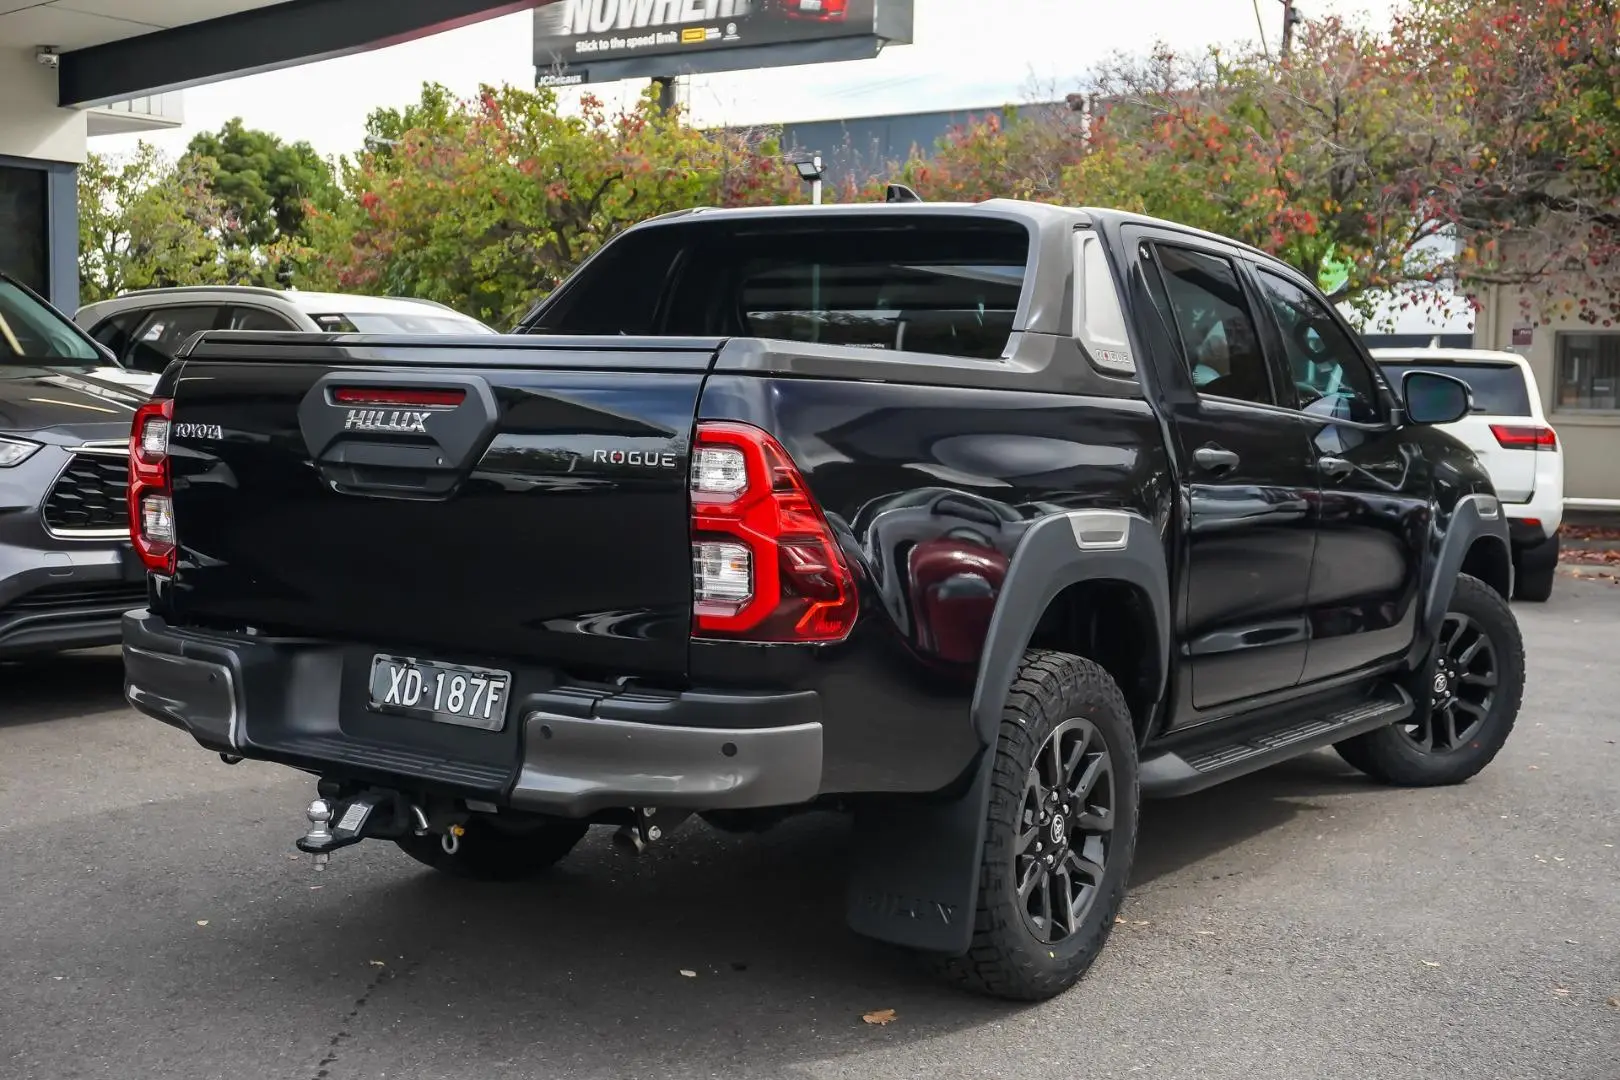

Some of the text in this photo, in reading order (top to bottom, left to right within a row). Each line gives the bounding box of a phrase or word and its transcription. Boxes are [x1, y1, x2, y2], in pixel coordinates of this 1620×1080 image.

[575, 40, 598, 53] Stick
[599, 40, 610, 50] to
[610, 37, 626, 49] the
[627, 33, 656, 48] speed
[656, 31, 678, 44] limit
[344, 409, 431, 432] HILUX
[175, 423, 224, 440] TOYOTA
[593, 449, 676, 467] ROGUE
